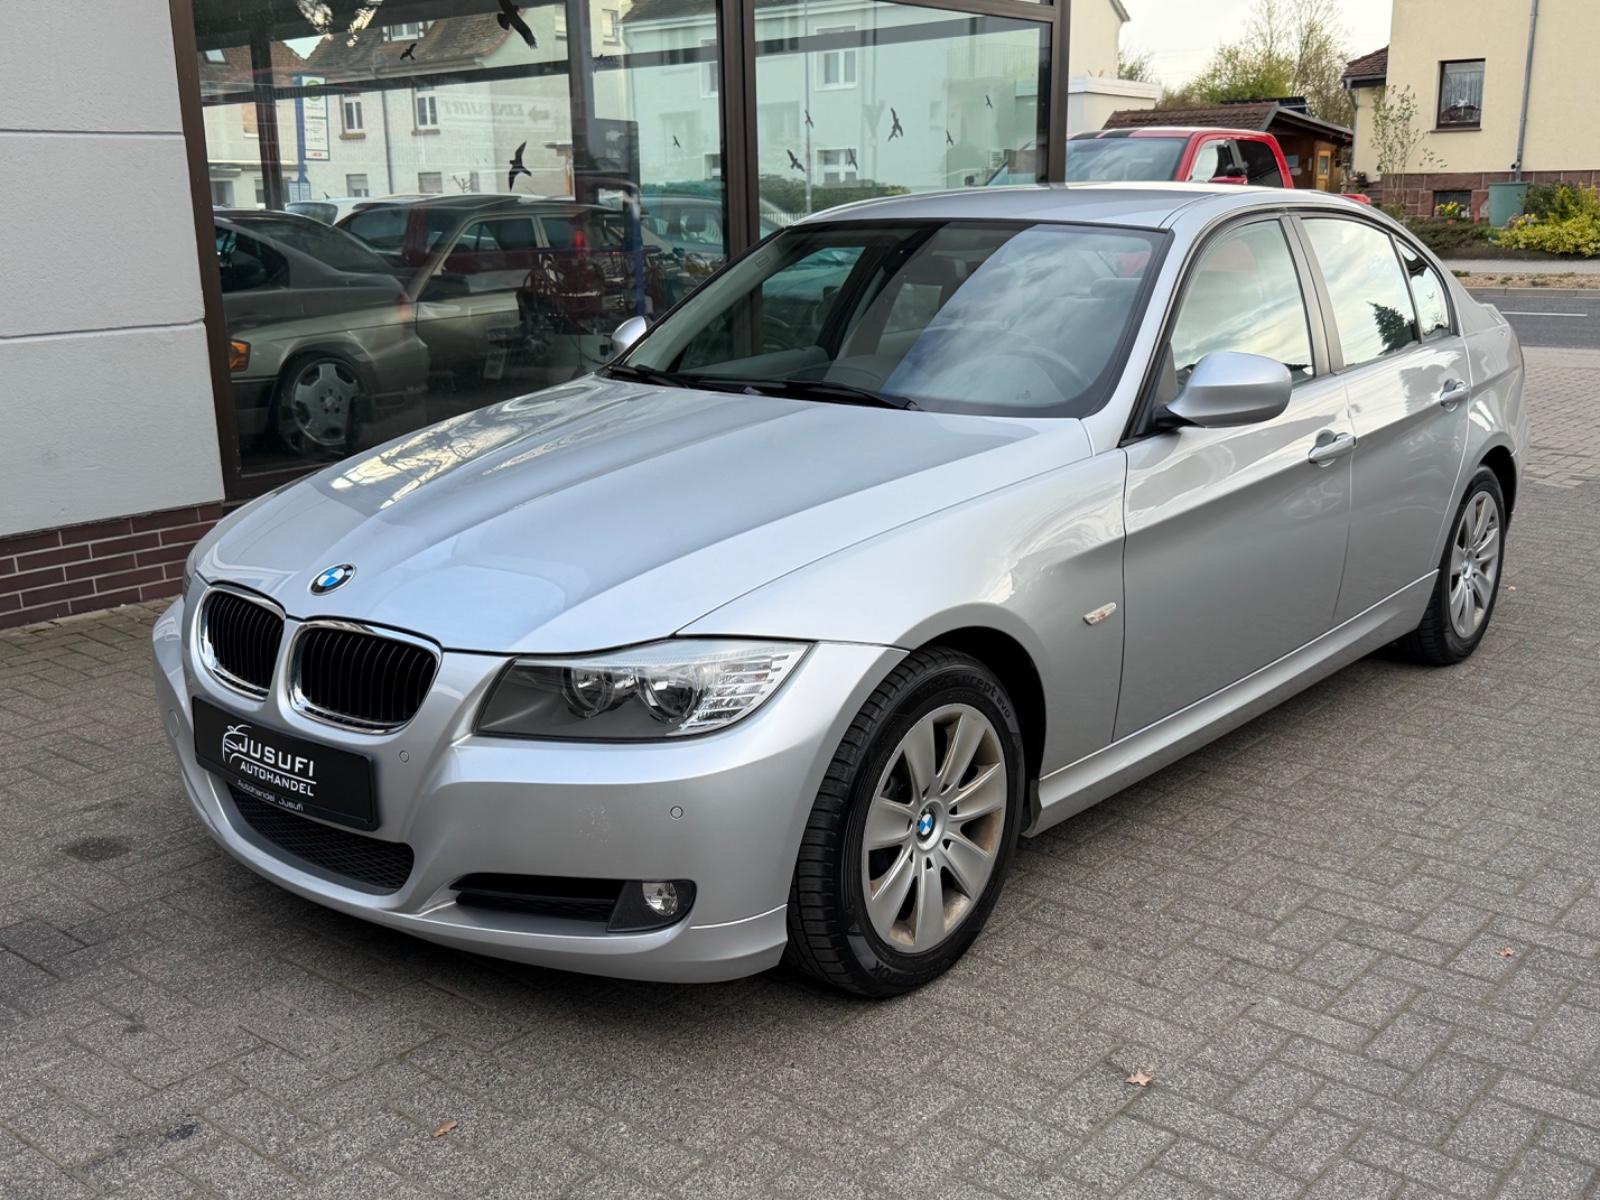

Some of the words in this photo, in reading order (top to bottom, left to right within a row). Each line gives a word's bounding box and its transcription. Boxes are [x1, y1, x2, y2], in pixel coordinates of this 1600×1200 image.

[239, 737, 314, 777] JUSUFI
[238, 779, 276, 803] Autohandel
[240, 760, 315, 797] AUTOHANDEL
